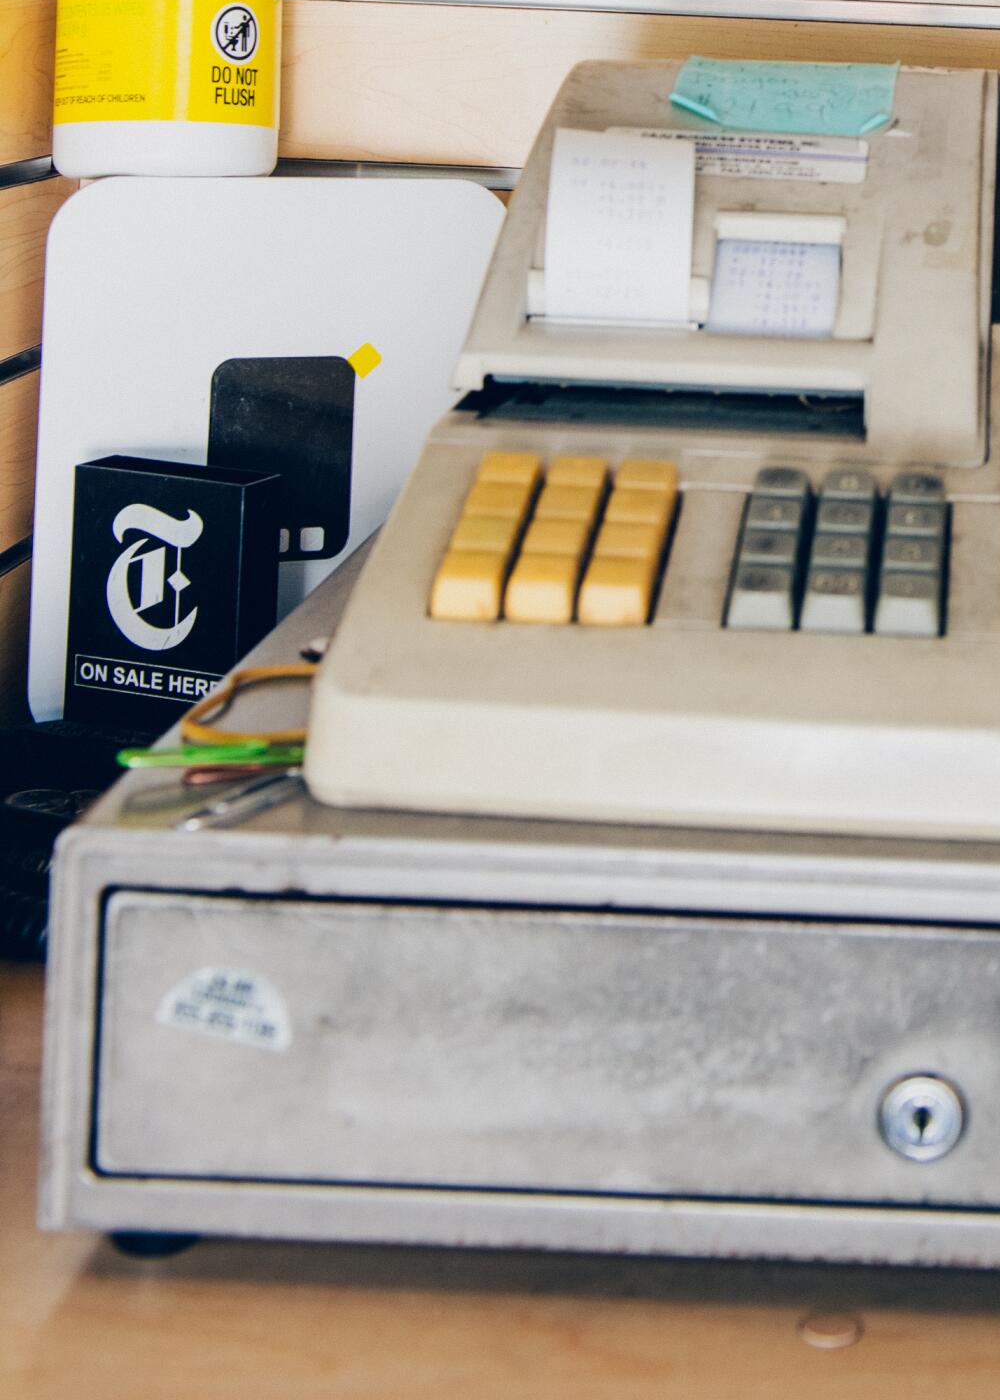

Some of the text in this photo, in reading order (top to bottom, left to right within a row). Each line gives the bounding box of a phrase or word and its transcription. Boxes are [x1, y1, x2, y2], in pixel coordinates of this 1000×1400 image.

[211, 66, 258, 86] DO NOT
[214, 88, 255, 106] FLUSH
[79, 662, 163, 691] ON SALE
